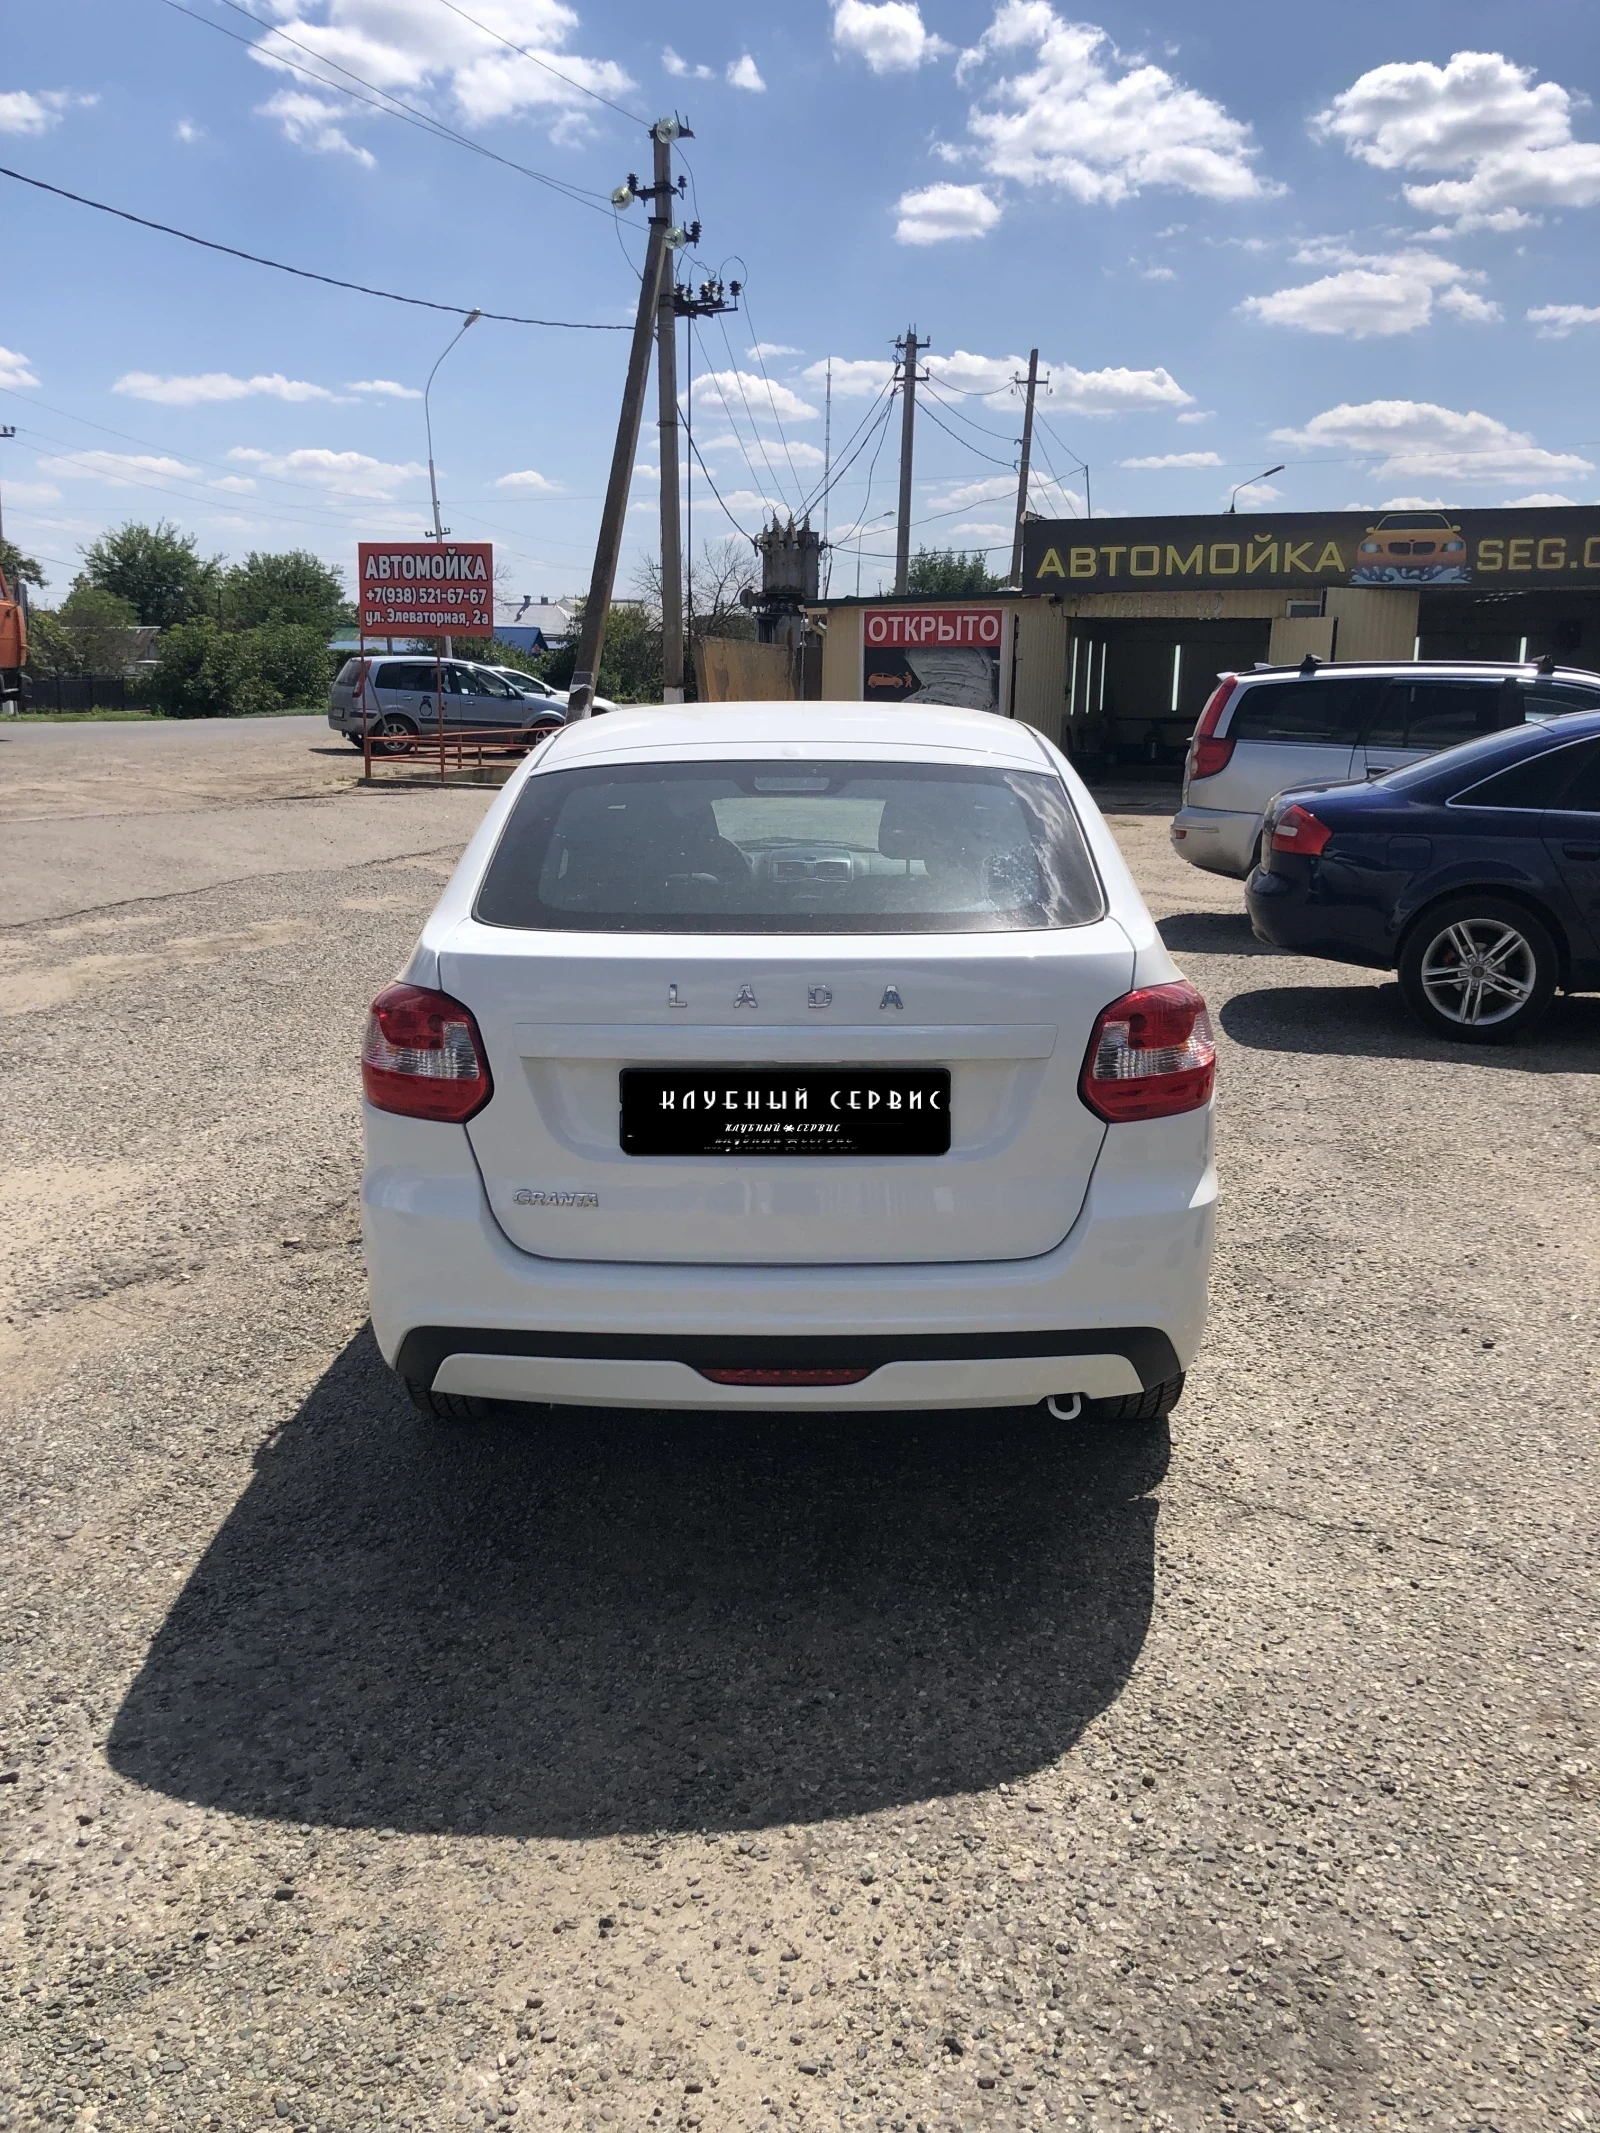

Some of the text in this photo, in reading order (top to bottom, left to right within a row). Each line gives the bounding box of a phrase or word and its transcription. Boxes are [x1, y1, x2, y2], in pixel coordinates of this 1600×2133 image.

[365, 548, 488, 580] АВТОМОЙКА
[1035, 534, 1346, 579] АВТОМОЙКА
[366, 587, 487, 606] +7(938) 521-67-67
[365, 608, 489, 628] ул. Элеваторная, 2а
[868, 615, 999, 642] ОТКРЫТО
[668, 983, 904, 1009] LADA
[513, 1189, 599, 1207] GRANTA
